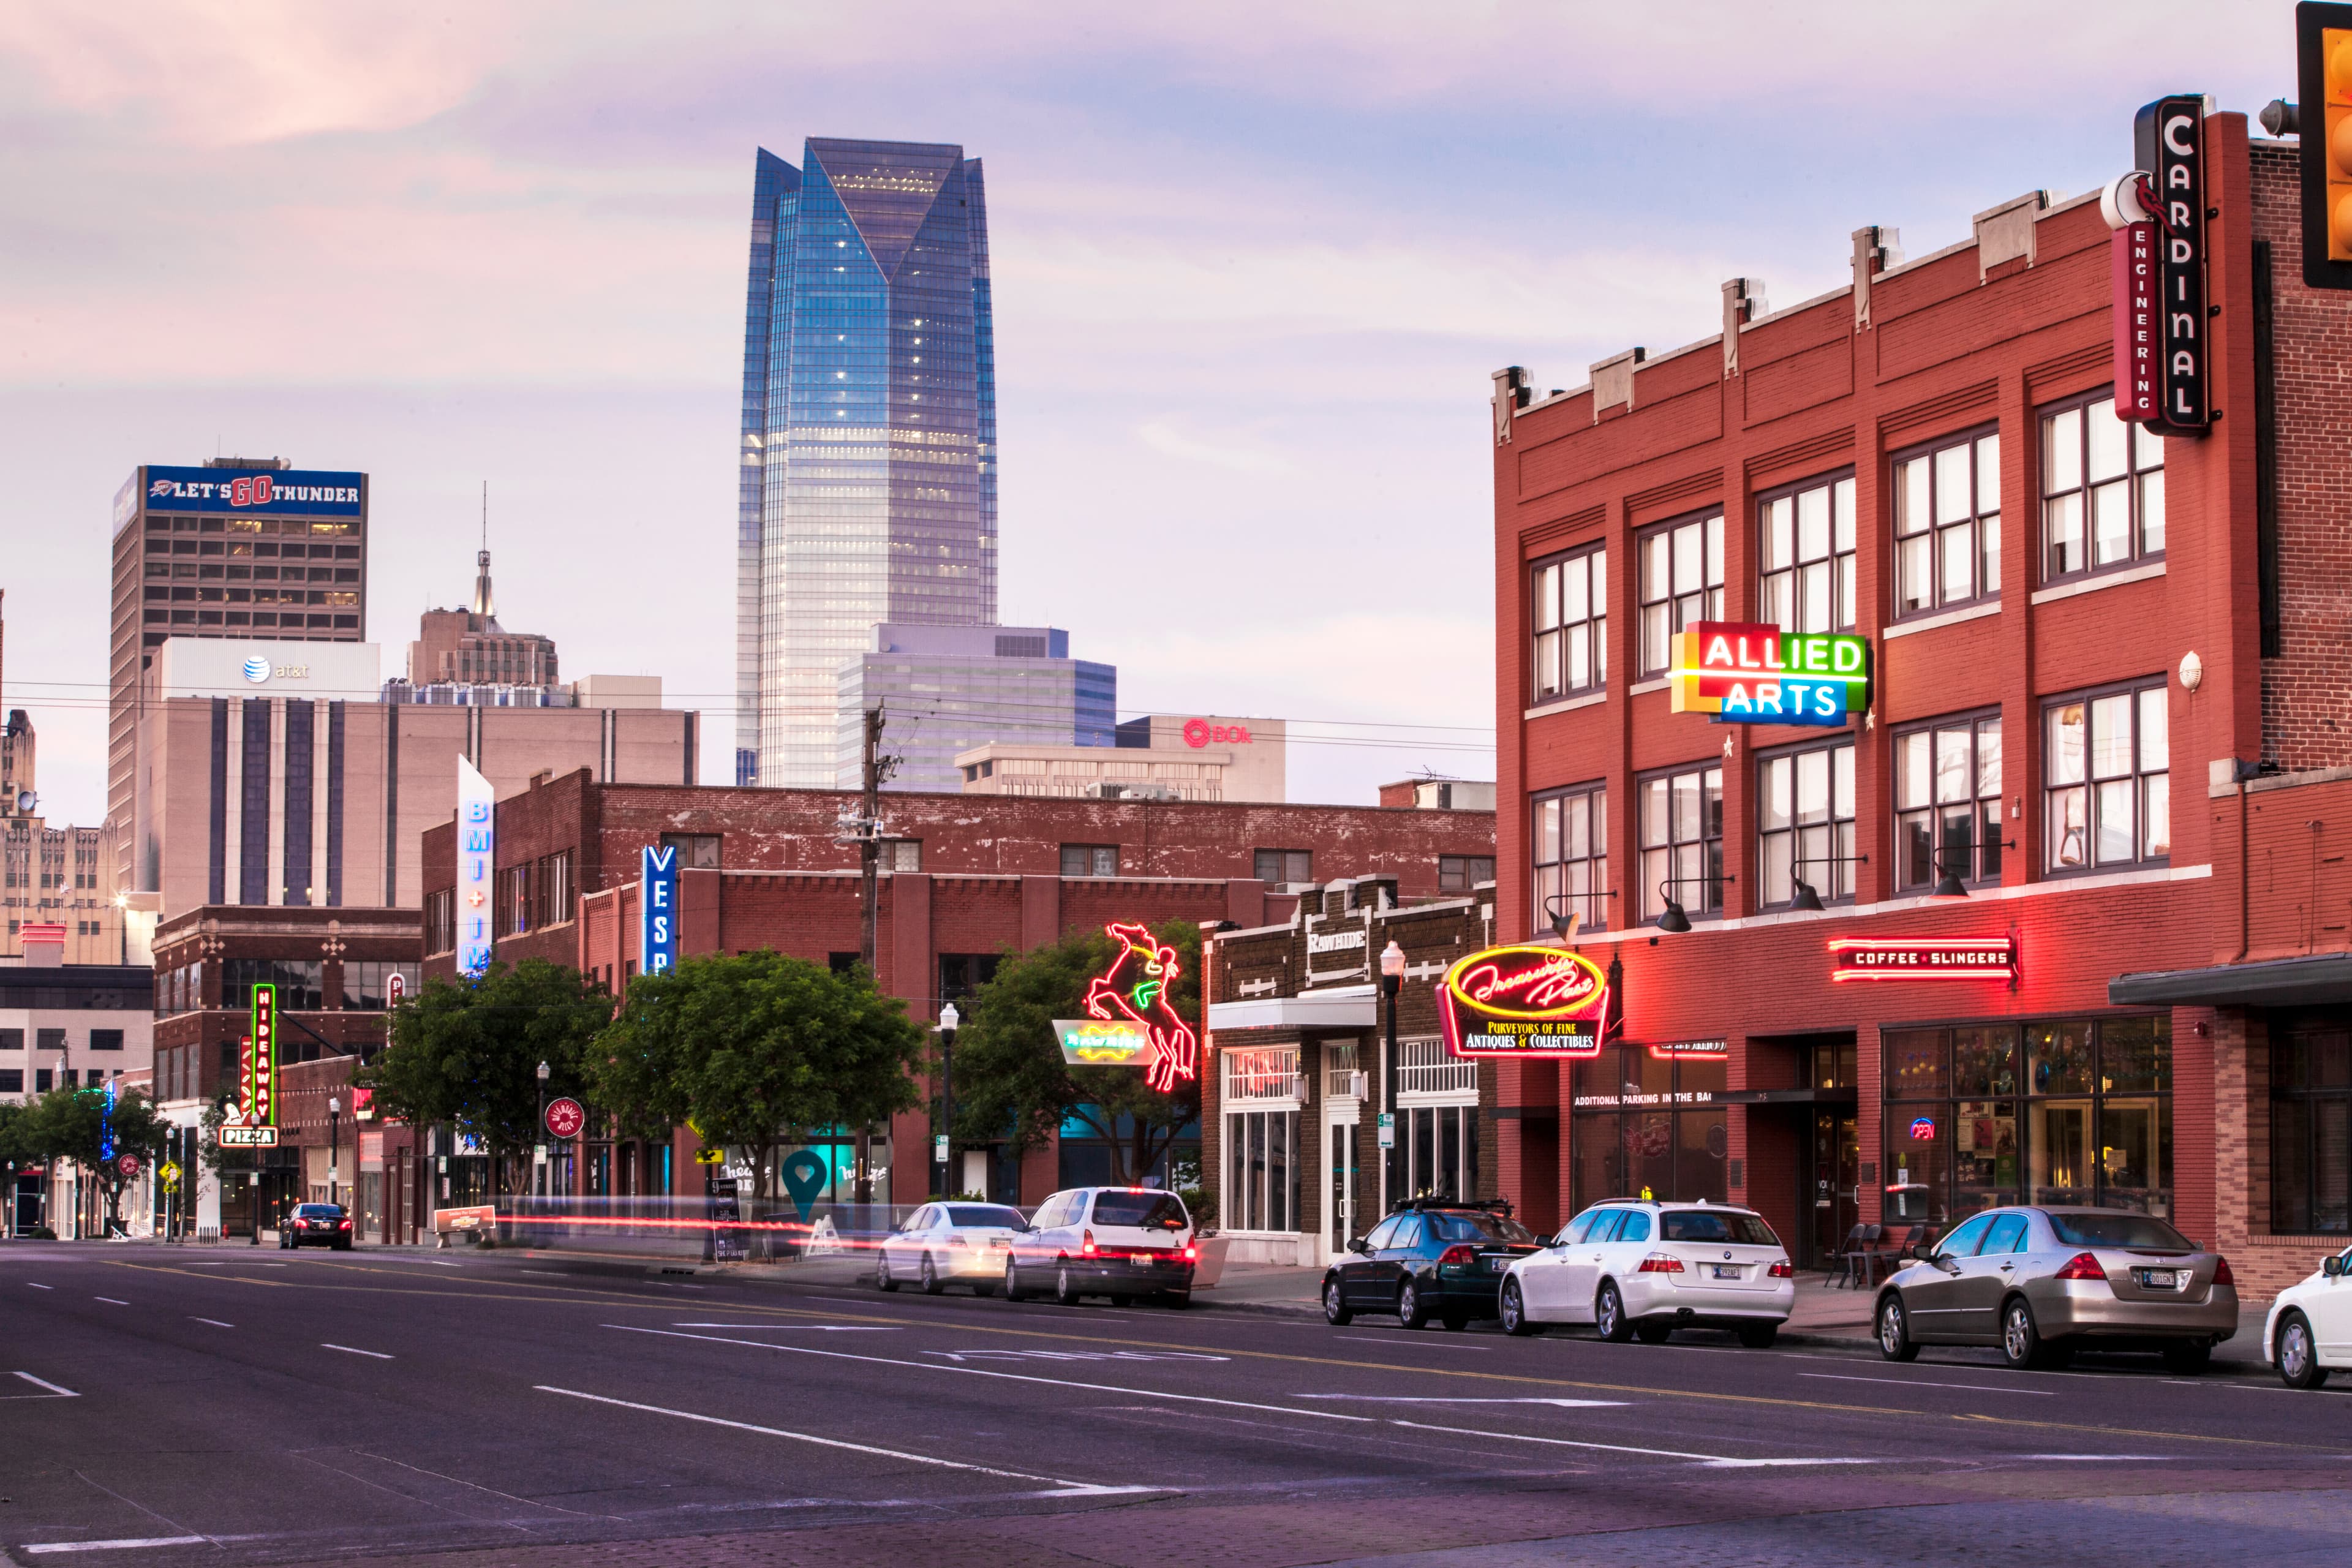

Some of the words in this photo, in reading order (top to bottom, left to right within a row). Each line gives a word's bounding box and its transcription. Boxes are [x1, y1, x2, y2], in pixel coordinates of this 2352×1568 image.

[2135, 230, 2150, 410] ENGINEERING
[174, 482, 232, 499] LET'S
[230, 475, 273, 507] GO
[271, 486, 359, 502] THUNDER
[1705, 635, 1861, 672] ALLIED
[276, 663, 309, 677] at&t
[1724, 682, 1837, 717] ARTS
[1309, 930, 1366, 953] RAWHIDE
[1855, 952, 1918, 964] COFFEE
[1931, 952, 2008, 964] SLINGERS
[1526, 971, 1594, 1006] Past
[1488, 1021, 1539, 1034] PURVEYORS
[1542, 1022, 1554, 1034] OF
[1556, 1023, 1577, 1034] FINE
[1466, 1033, 1516, 1049] ANTIQUES
[1518, 1034, 1526, 1047] &
[1530, 1033, 1594, 1048] COLLECTIBLES
[257, 991, 270, 1118] HIDEAWAY
[1574, 1095, 1619, 1106] ADDITIONAL
[1623, 1094, 1659, 1104] PARKING
[1662, 1093, 1672, 1102] IN
[1675, 1093, 1692, 1102] THE
[225, 1130, 273, 1144] PIZZA
[1912, 1123, 1935, 1140] OPEN
[712, 1181, 720, 1194] 9
